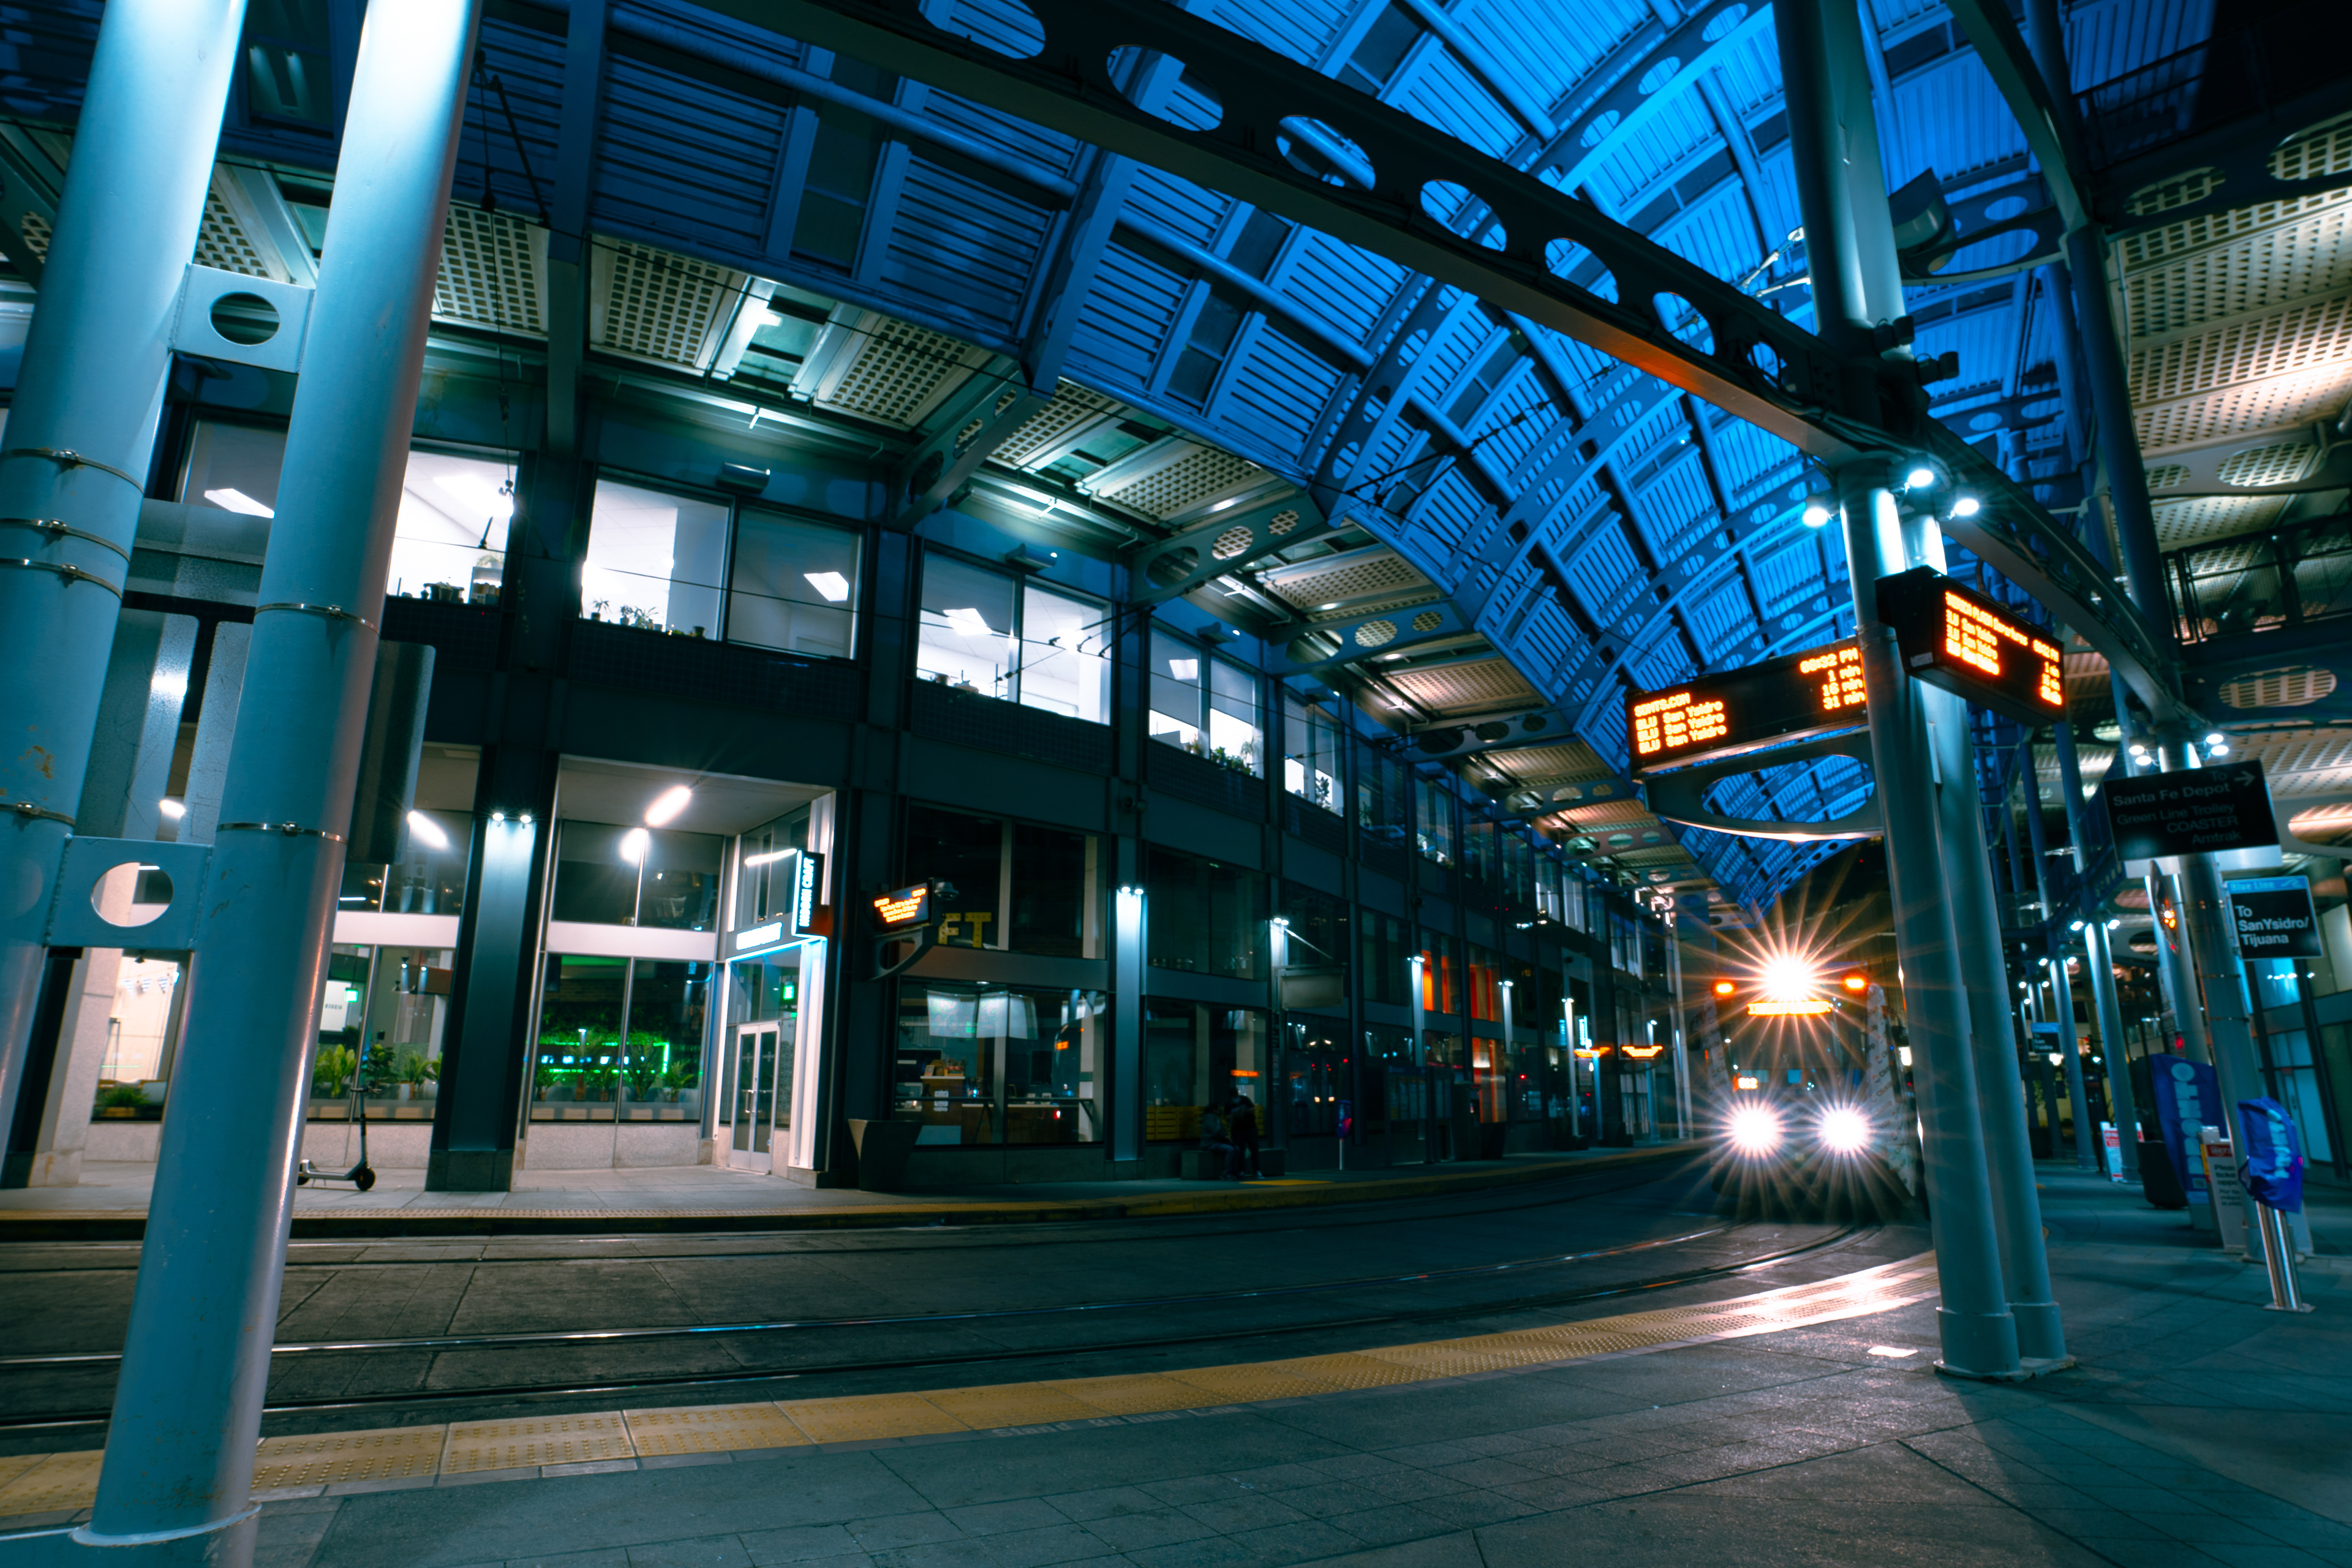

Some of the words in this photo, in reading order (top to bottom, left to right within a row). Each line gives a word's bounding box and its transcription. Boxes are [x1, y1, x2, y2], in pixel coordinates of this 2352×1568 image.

[1839, 647, 1858, 663] PM
[1635, 715, 1657, 731] BLU
[1662, 711, 1685, 723] San
[1686, 701, 1723, 717] Ysidro
[1828, 669, 1836, 682] 1
[1839, 665, 1861, 679] min
[1637, 727, 1659, 742] BLU
[1664, 723, 1686, 735] San
[1687, 713, 1725, 729] Ysidro
[1822, 682, 1839, 696] 16
[1841, 678, 1863, 692] min
[1638, 739, 1660, 754] BLU
[1665, 734, 1688, 747] San
[1689, 725, 1727, 741] Ysidro
[1823, 695, 1841, 710] 31
[1844, 691, 1865, 705] min
[2209, 770, 2227, 782] To
[2113, 792, 2156, 807] Santa
[2160, 789, 2179, 801] Fe
[2182, 782, 2231, 797] Depot
[2117, 812, 2157, 825] Green
[2160, 809, 2188, 820] Line
[2190, 803, 2235, 816] Trolley
[2166, 815, 2239, 833] COASTER
[2192, 830, 2242, 845] Amtrak
[802, 858, 815, 888] CRAFT
[2254, 881, 2275, 889] Line
[2234, 905, 2253, 918] To
[2240, 933, 2290, 948] Tijuana
